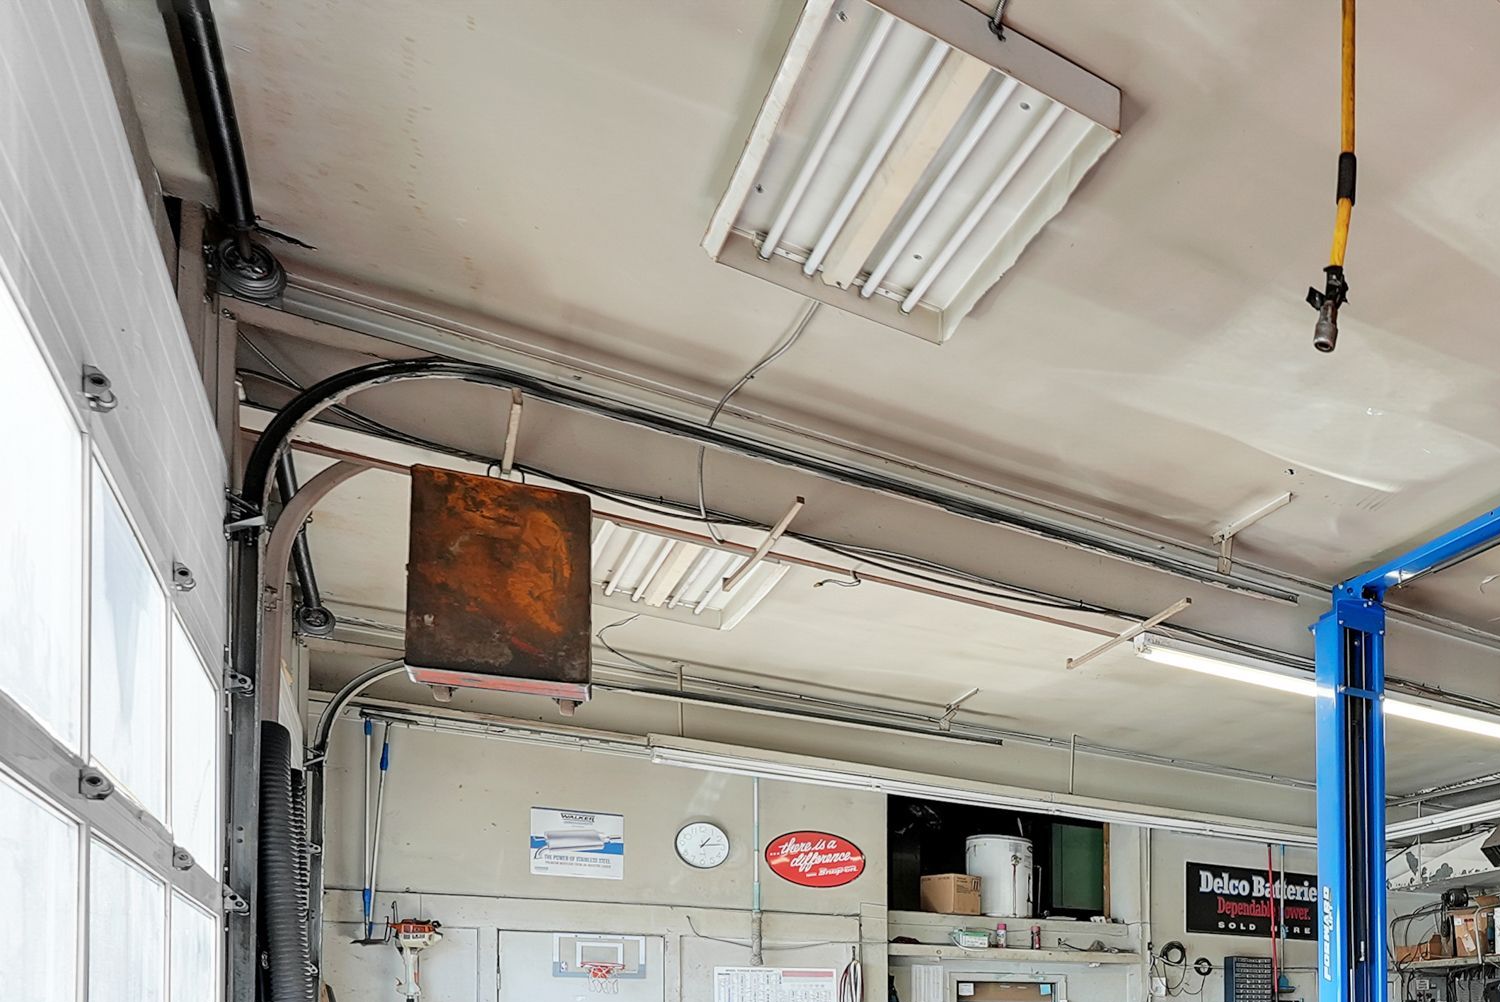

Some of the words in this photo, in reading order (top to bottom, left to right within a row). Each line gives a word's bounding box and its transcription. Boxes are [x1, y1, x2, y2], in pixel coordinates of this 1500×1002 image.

[560, 812, 596, 823] WALKER
[812, 839, 826, 850] is
[826, 840, 838, 850] a
[789, 851, 852, 873] difference
[1199, 869, 1250, 897] Delco
[1217, 896, 1276, 919] Dependabl
[1218, 921, 1256, 931] SOLD
[1322, 885, 1332, 982] FORWARD
